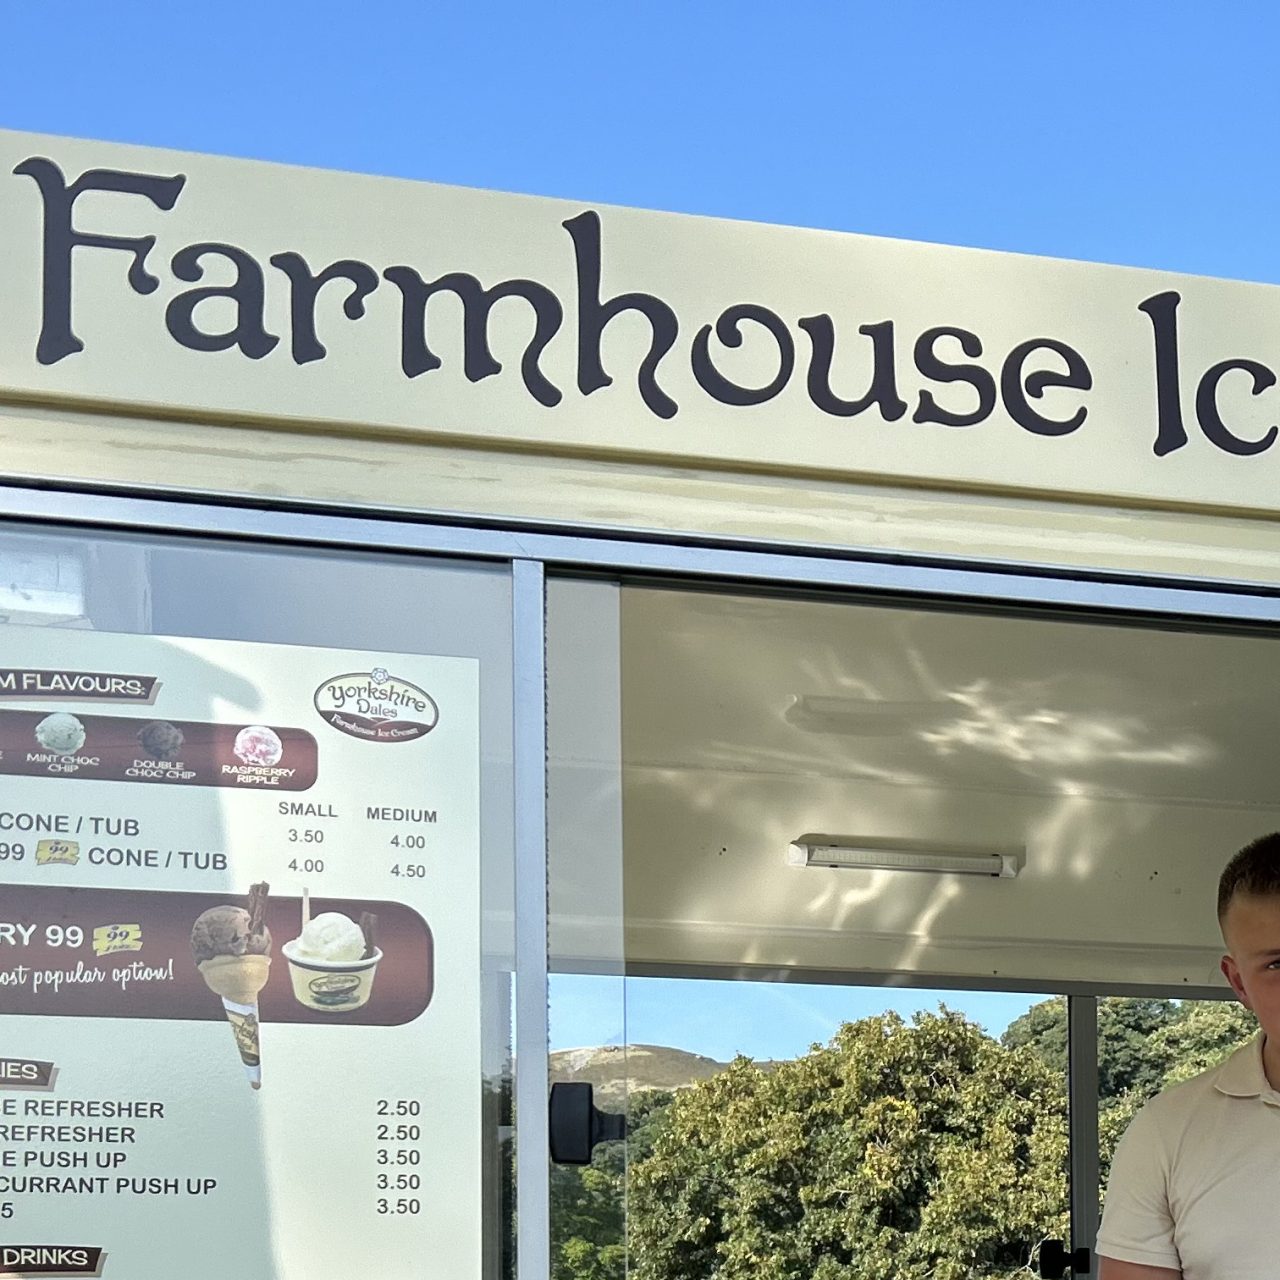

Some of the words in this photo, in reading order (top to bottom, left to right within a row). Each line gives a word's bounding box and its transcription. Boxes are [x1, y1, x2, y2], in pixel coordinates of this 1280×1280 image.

[12, 155, 1094, 437] Farmhouse
[22, 673, 146, 696] FLAVOURS:
[356, 698, 398, 718] Dales
[331, 713, 377, 736] Farmhouse
[378, 728, 390, 737] Ice
[391, 727, 419, 737] Cream
[26, 752, 59, 763] MINT
[61, 755, 100, 766] CHOC
[47, 764, 79, 773] CHIP
[133, 759, 185, 771] DOUBLE
[125, 768, 162, 778] CHOC
[166, 770, 196, 779] CHIP
[221, 765, 296, 778] RASPBERRY
[236, 774, 280, 785] RIPPLE
[278, 801, 339, 818] SMALL
[366, 807, 438, 823] MEDIUM
[0, 812, 69, 834] CONE
[76, 816, 83, 834] /
[89, 817, 140, 836] TUB
[288, 828, 324, 844] 3.50
[390, 834, 426, 849] 4.00
[0, 842, 25, 861] 99
[88, 847, 159, 868] CONE
[165, 851, 172, 868] /
[178, 851, 228, 870] TUB
[287, 858, 325, 873] 4.00
[390, 863, 426, 878] 4.50
[45, 924, 84, 948] 99
[33, 960, 105, 993] popular
[111, 958, 175, 991] option!
[0, 1063, 38, 1080] IES
[0, 1099, 17, 1116] E
[24, 1099, 165, 1119] REFRESHER
[376, 1099, 421, 1116] 2.50
[0, 1124, 136, 1144] REFRESHER
[376, 1124, 421, 1141] 2.50
[24, 1150, 88, 1168] PUSH
[95, 1151, 127, 1169] UP
[376, 1149, 421, 1166] 3.50
[0, 1176, 109, 1194] CURRANT
[116, 1177, 179, 1195] PUSH
[186, 1178, 217, 1195] UP
[376, 1174, 421, 1190] 3.50
[1, 1201, 14, 1219] 5
[376, 1198, 421, 1215] 3.50
[3, 1248, 88, 1266] DRINKS
